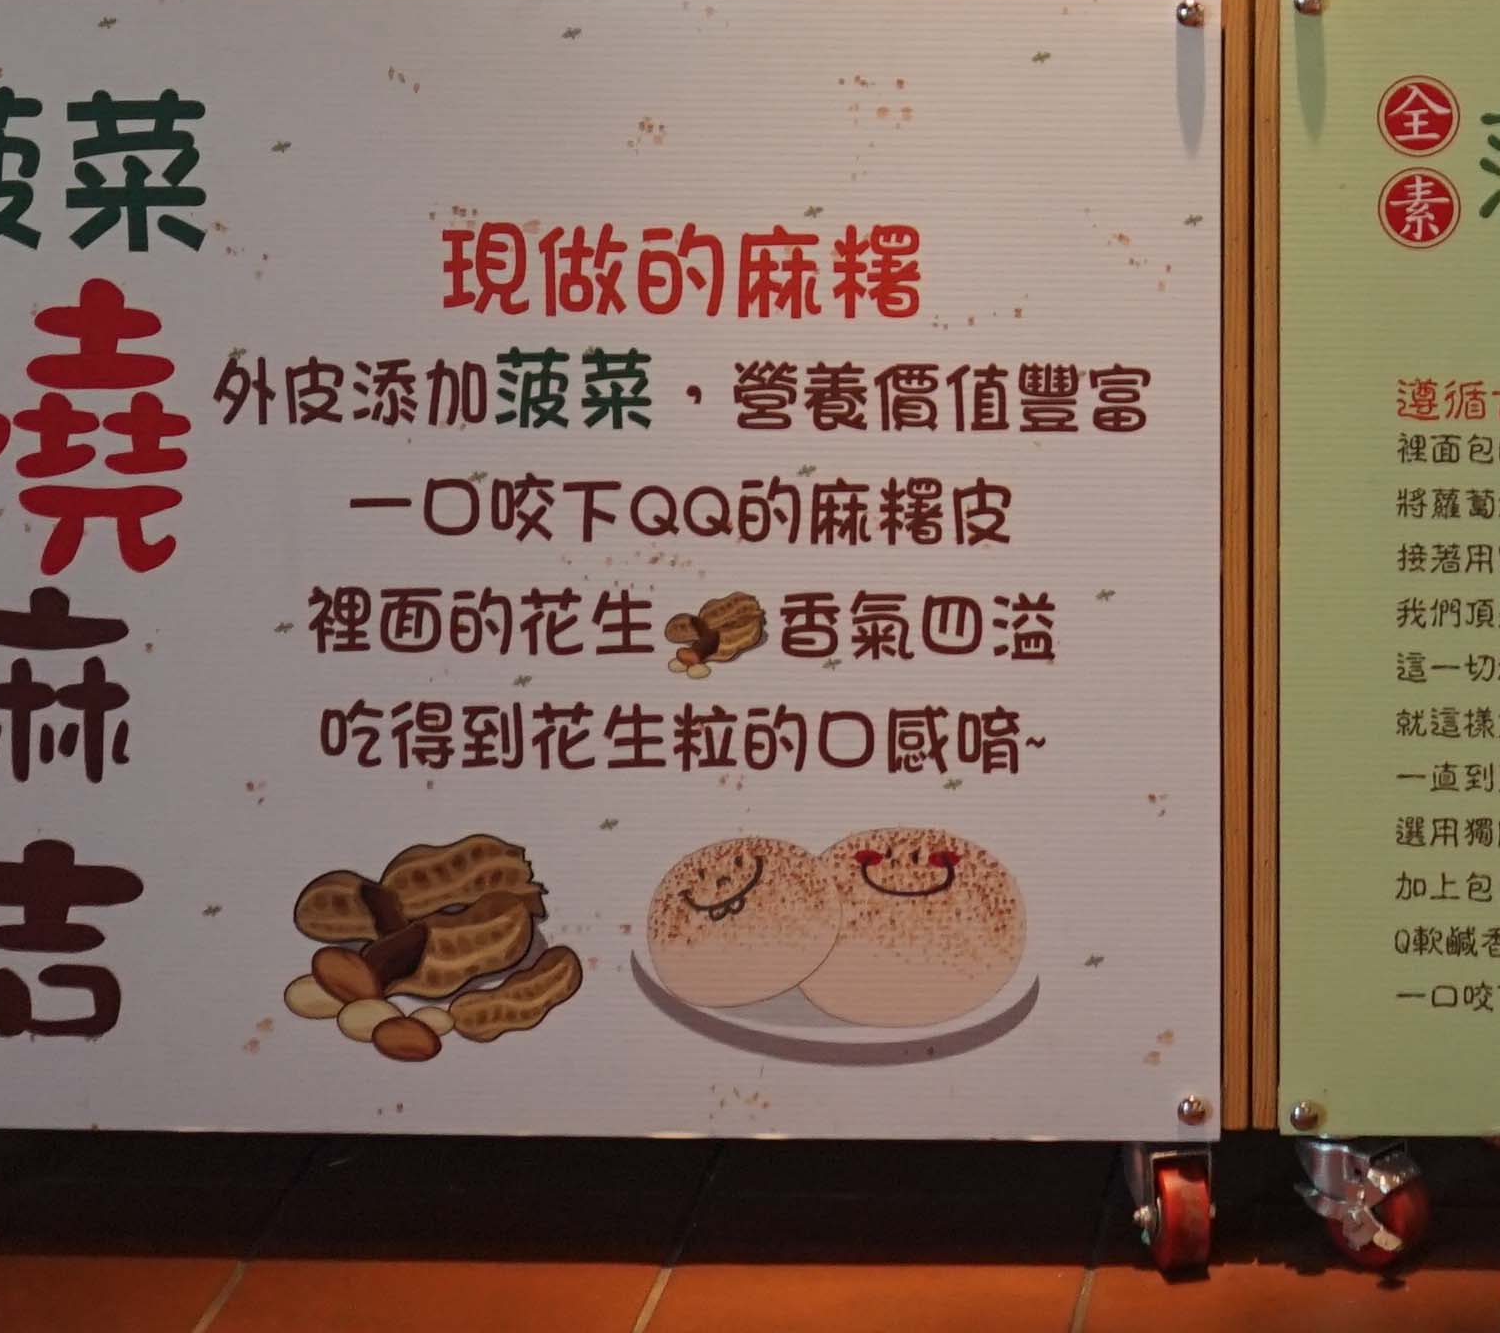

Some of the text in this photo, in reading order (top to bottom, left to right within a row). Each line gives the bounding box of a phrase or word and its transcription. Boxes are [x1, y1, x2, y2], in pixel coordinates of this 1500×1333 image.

[441, 222, 923, 321] 現做的麻糬
[349, 477, 1013, 547] 一口咬下QQ的麻糬皮
[308, 586, 1057, 663] 裡面的花生 香氣四溢
